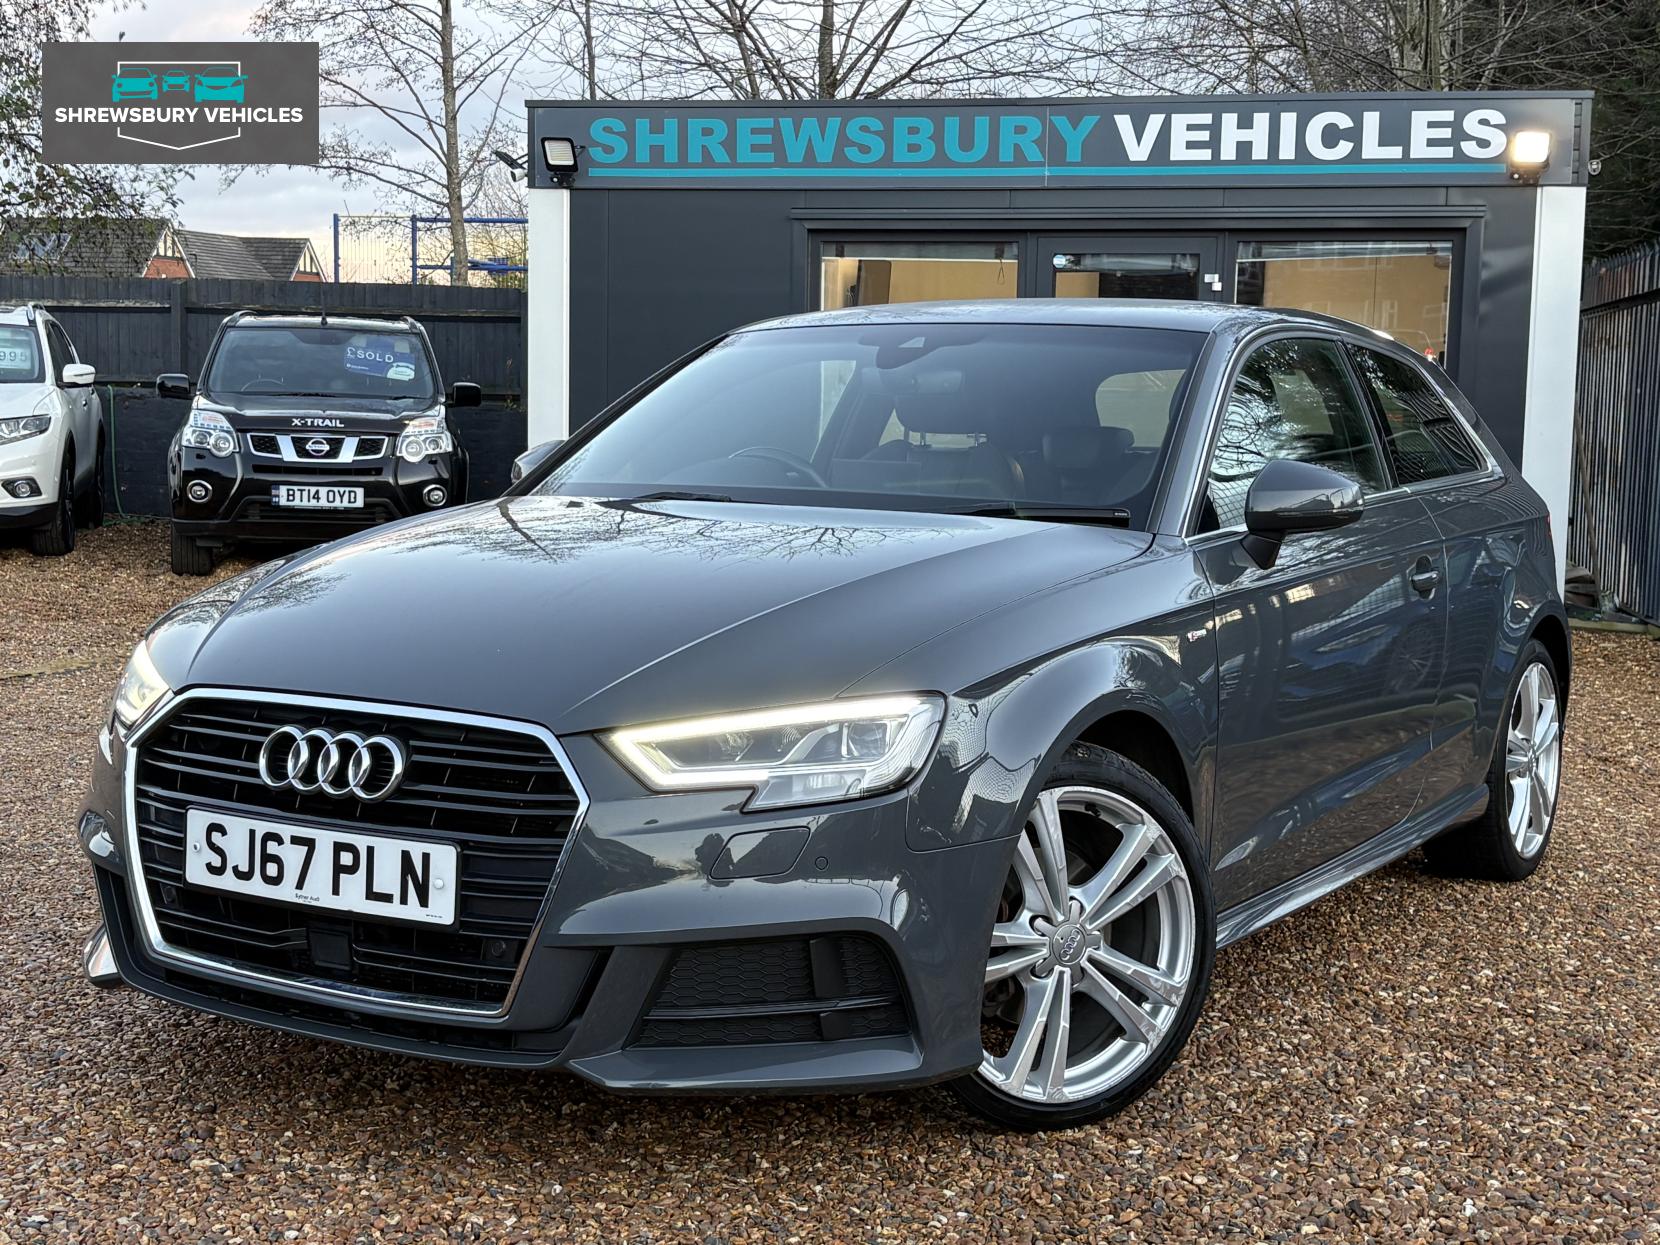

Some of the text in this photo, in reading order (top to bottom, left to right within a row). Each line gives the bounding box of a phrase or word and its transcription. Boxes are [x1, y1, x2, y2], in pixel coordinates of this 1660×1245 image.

[588, 108, 1508, 165] SHREWSBURY VEHICLES
[291, 418, 345, 427] X-TRAIL
[286, 488, 357, 504] BT14 OYD
[204, 821, 431, 909] SJ67 PLN
